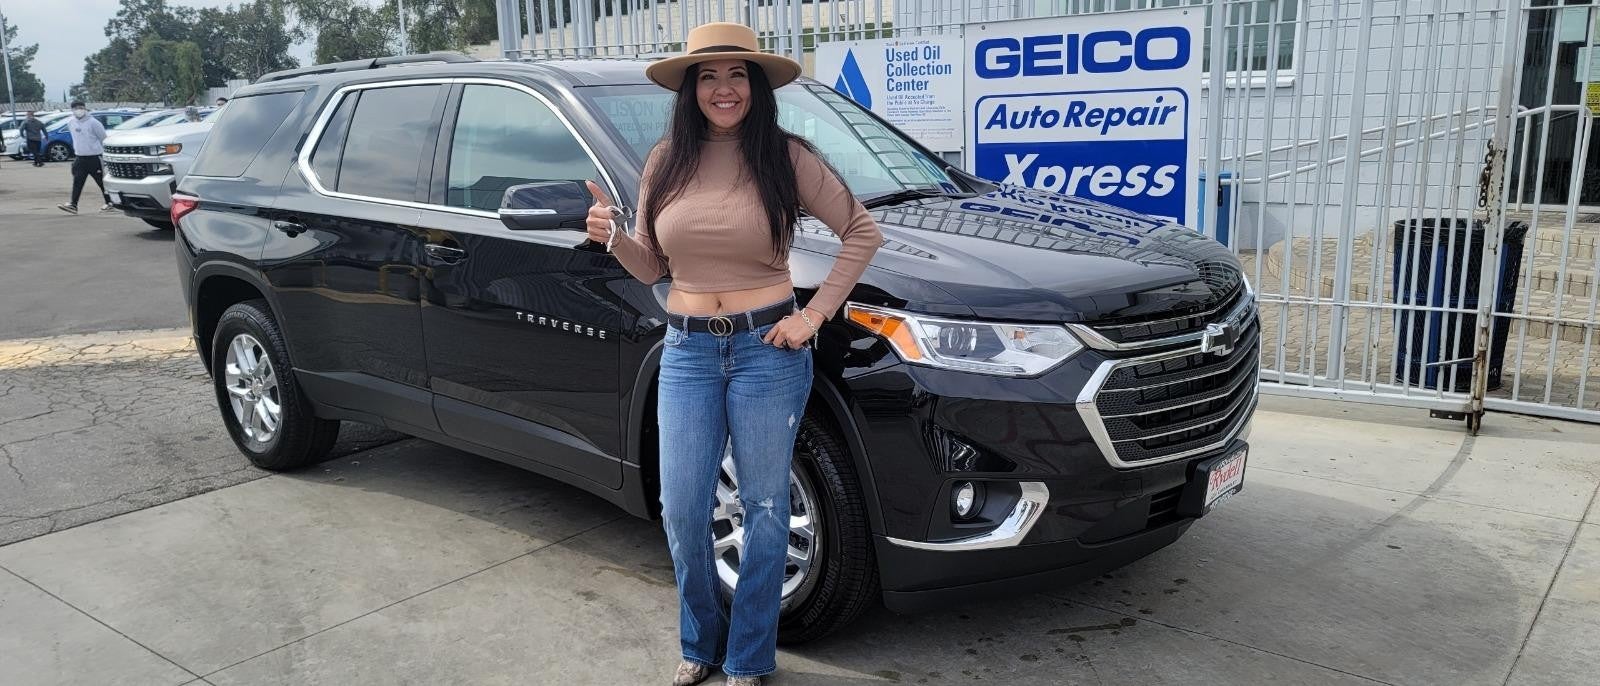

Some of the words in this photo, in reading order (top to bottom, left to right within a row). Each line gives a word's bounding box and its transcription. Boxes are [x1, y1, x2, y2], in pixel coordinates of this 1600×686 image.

[886, 47, 918, 62] Used
[924, 45, 940, 60] Oil
[975, 26, 1191, 79] GEICO
[886, 61, 952, 77] Collection
[887, 78, 929, 92] Center
[985, 104, 1060, 130] Auto
[1063, 96, 1177, 135] Repair
[1001, 153, 1180, 197] Xpress
[515, 312, 606, 339] TRAVERSE
[1210, 457, 1242, 492] Rydell
